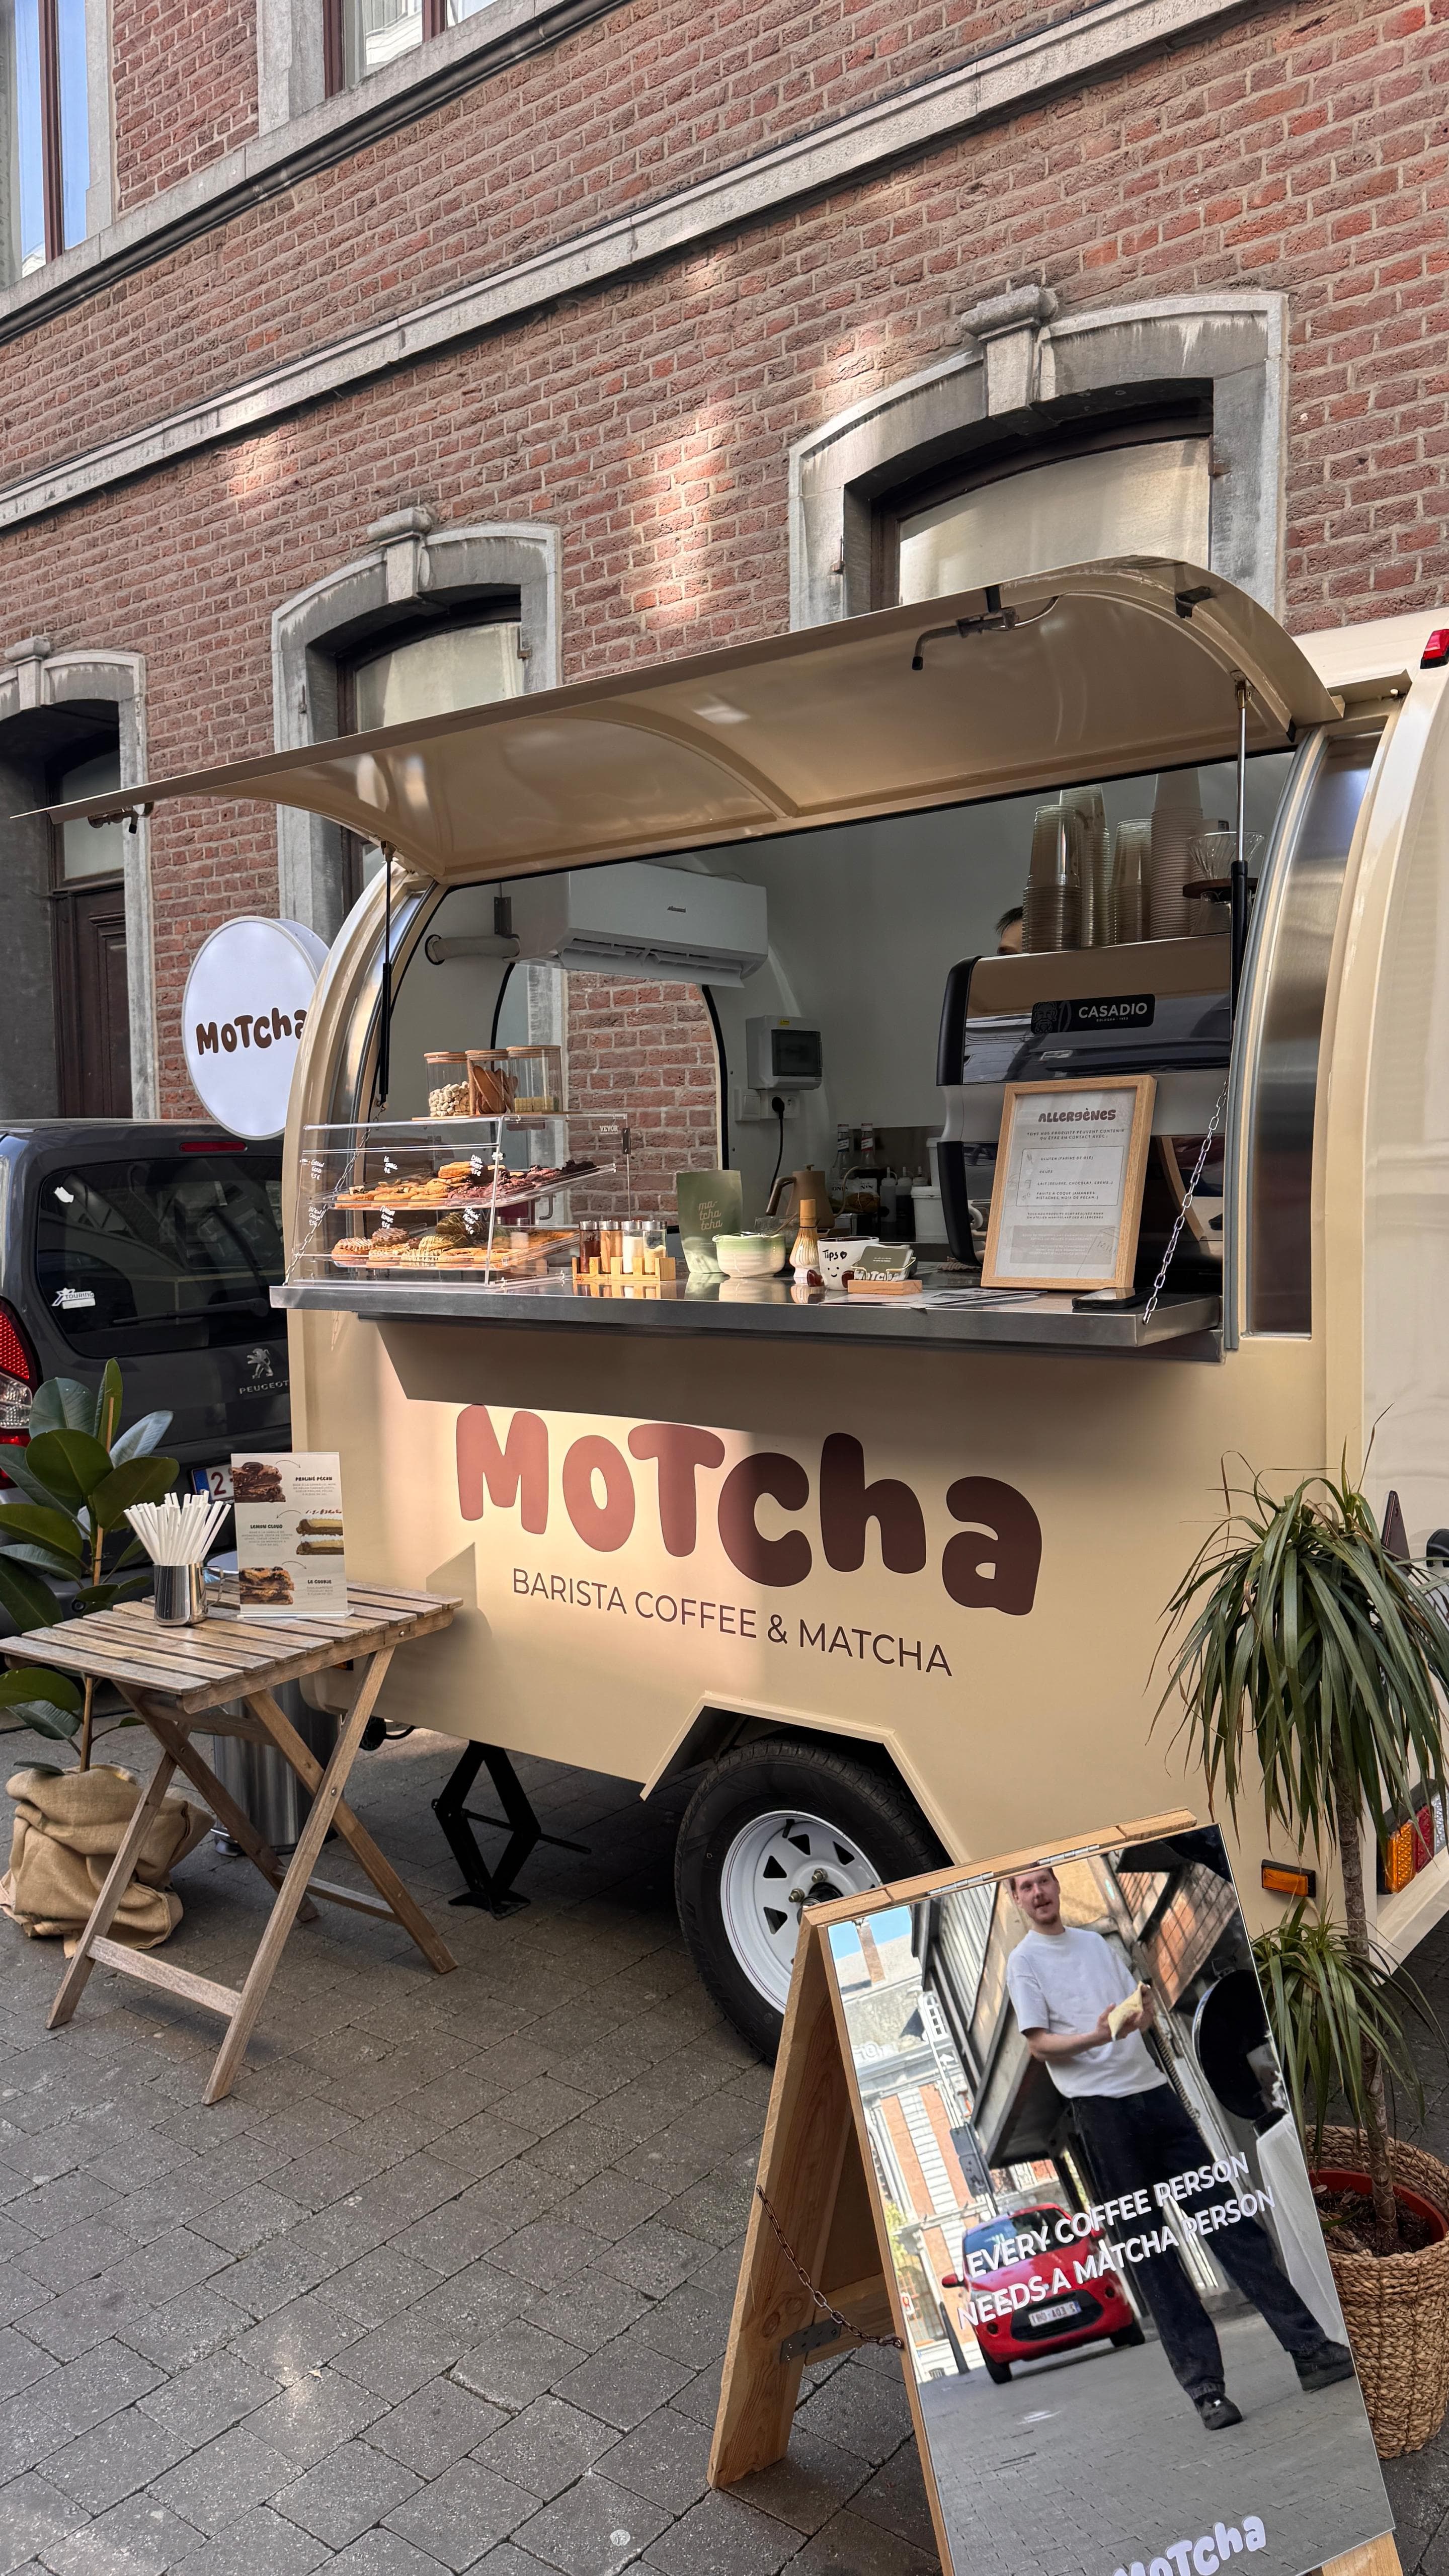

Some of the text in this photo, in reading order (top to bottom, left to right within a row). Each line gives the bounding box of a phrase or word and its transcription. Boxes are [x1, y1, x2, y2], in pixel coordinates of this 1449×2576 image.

[1078, 1002, 1148, 1018] CASADIO
[699, 1209, 722, 1221] tcha
[700, 1219, 723, 1231] tcha
[822, 1249, 839, 1261] Tips
[239, 1380, 289, 1395] PEUGEOT
[513, 1568, 953, 1677] BARISTA COFFEE & MATCHA
[965, 2151, 1249, 2278] EVERY COFFEE PERSON
[957, 2185, 1275, 2330] NEEDS A MATCHA PERSON
